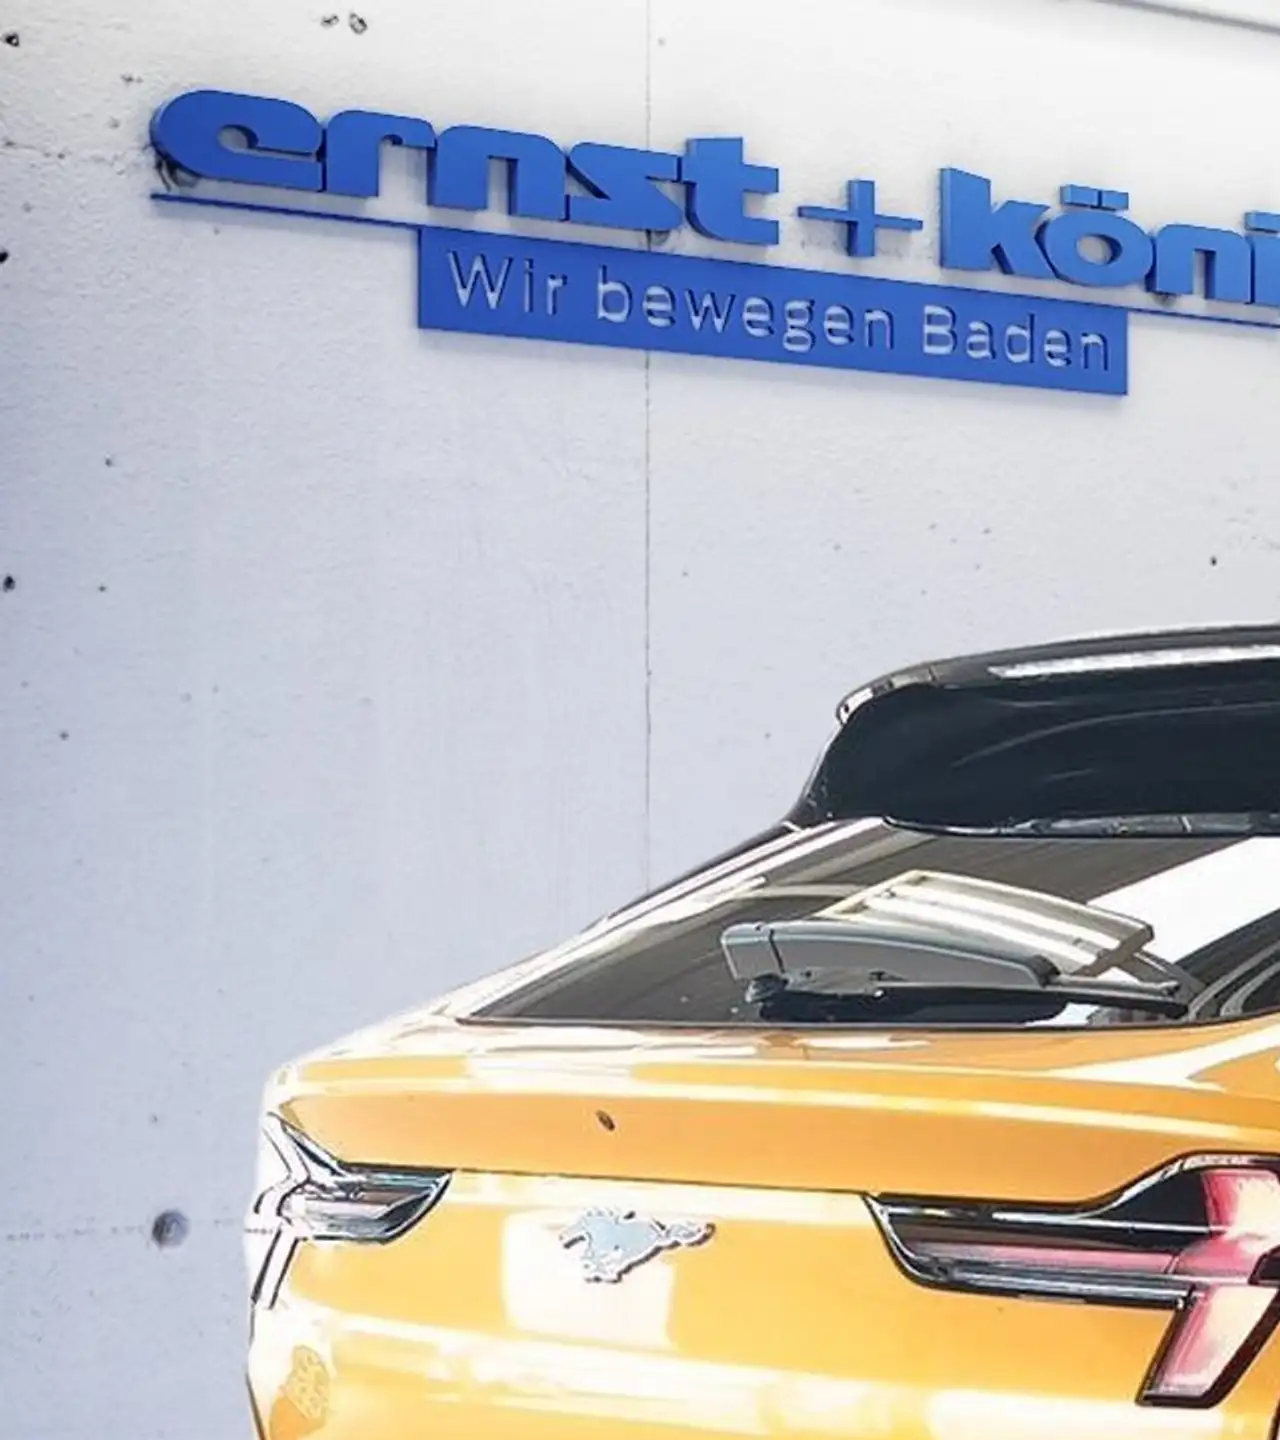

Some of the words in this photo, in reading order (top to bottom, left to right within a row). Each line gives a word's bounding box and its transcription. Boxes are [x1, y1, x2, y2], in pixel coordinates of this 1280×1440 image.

[448, 250, 567, 315] Wir
[597, 264, 894, 353] bewegen
[922, 303, 1111, 372] Baden
